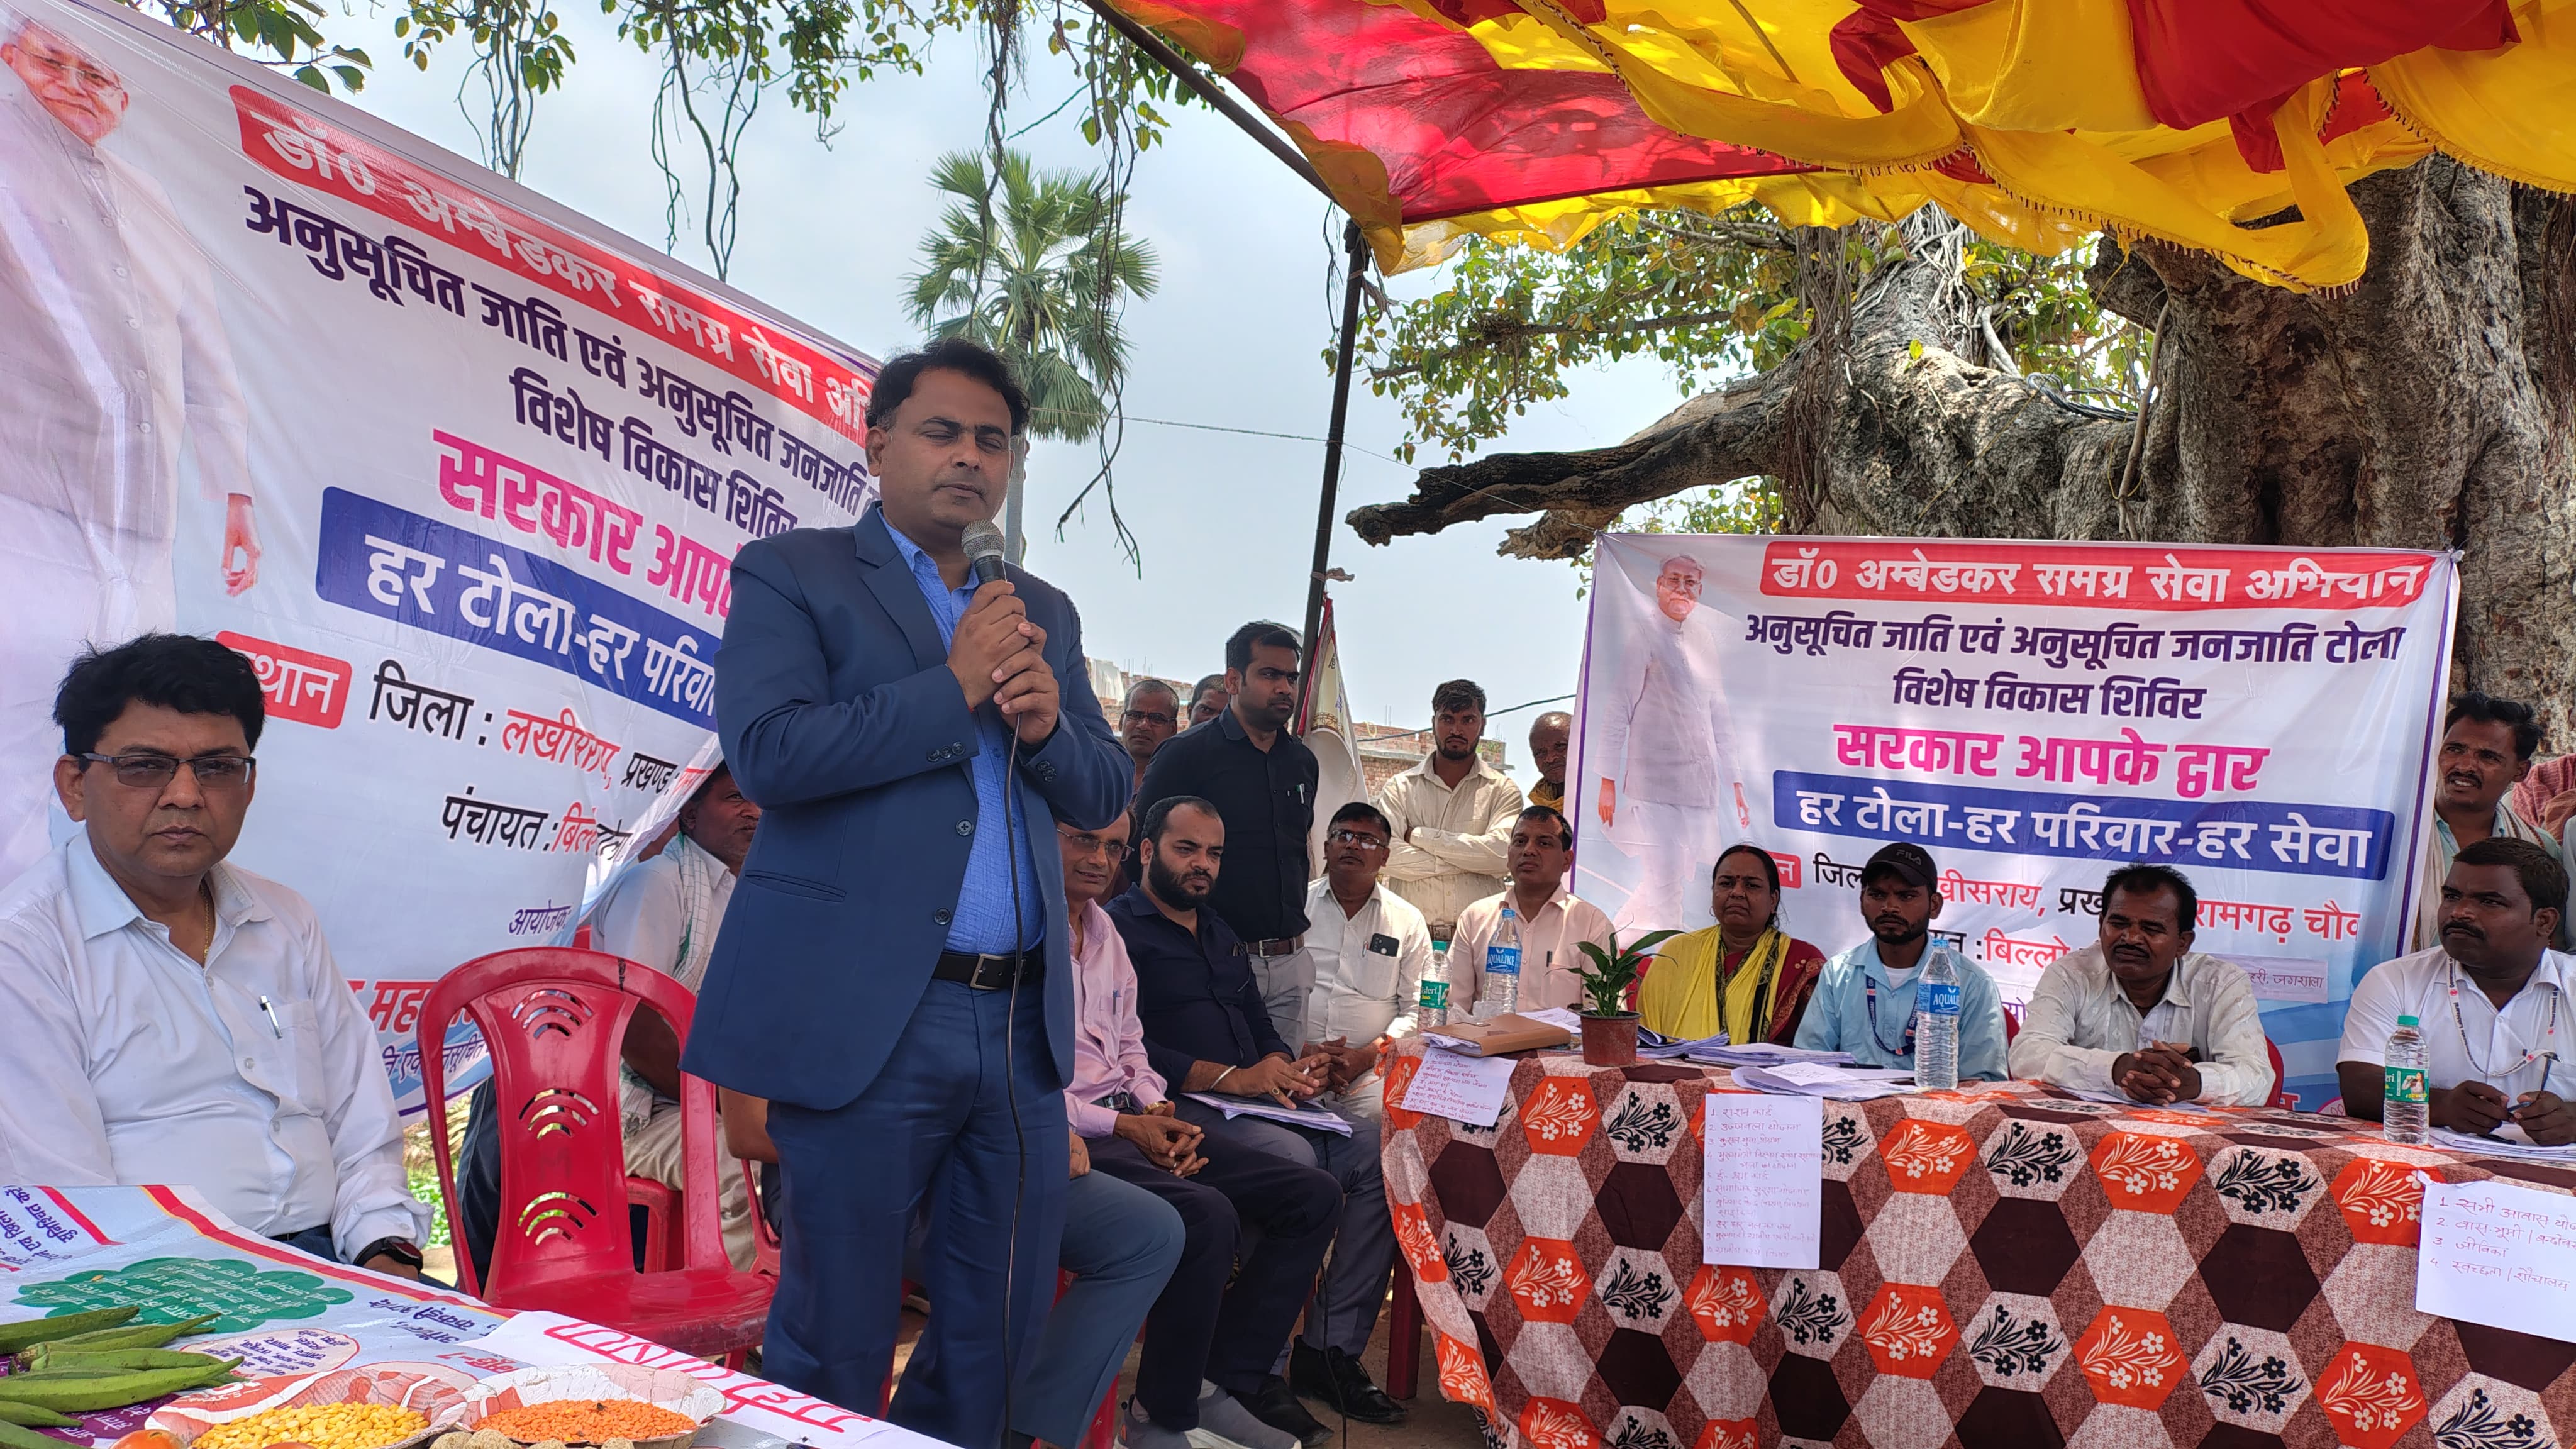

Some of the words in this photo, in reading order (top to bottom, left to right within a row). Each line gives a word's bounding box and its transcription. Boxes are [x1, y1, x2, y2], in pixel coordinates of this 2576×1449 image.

[402, 180, 621, 307] अम्बेडकर
[630, 279, 734, 362] समग्र
[741, 326, 813, 403] सेवा
[243, 185, 465, 318] अनुसूचित
[471, 281, 568, 362] जाति
[574, 335, 626, 389] एवं
[636, 358, 773, 462] अनुसूचित
[779, 429, 867, 516] जनजाति
[510, 367, 614, 462] विशेष
[620, 416, 721, 514] विकास
[433, 428, 642, 575] सरकार
[1857, 548, 2021, 594] अम्बेडकर
[2033, 564, 2132, 599] समग्र
[2146, 553, 2230, 602] सेवा
[2246, 558, 2424, 599] अभियान
[364, 534, 445, 614] हर
[643, 635, 715, 716] परिवा
[1746, 610, 1877, 656] अनुसूचित
[1882, 614, 1953, 653] जाति
[1959, 617, 2005, 654] एवं
[2011, 621, 2164, 670] अनुसूचित
[2170, 621, 2319, 663] जनजाति
[2324, 619, 2406, 663] टोला
[1893, 666, 1979, 708] विशेष
[1985, 670, 2094, 715] विकास
[2099, 675, 2207, 719] शिविर
[1833, 724, 2004, 777] सरकार
[2015, 727, 2167, 786] आपके
[2175, 743, 2270, 798] द्वार
[1796, 791, 1845, 826] हर
[2269, 813, 2373, 868] सेवा
[1896, 848, 1922, 867] FILA
[1813, 852, 1863, 889] जिल
[1422, 986, 1438, 994] isleri
[2500, 1208, 2548, 1228] आवास
